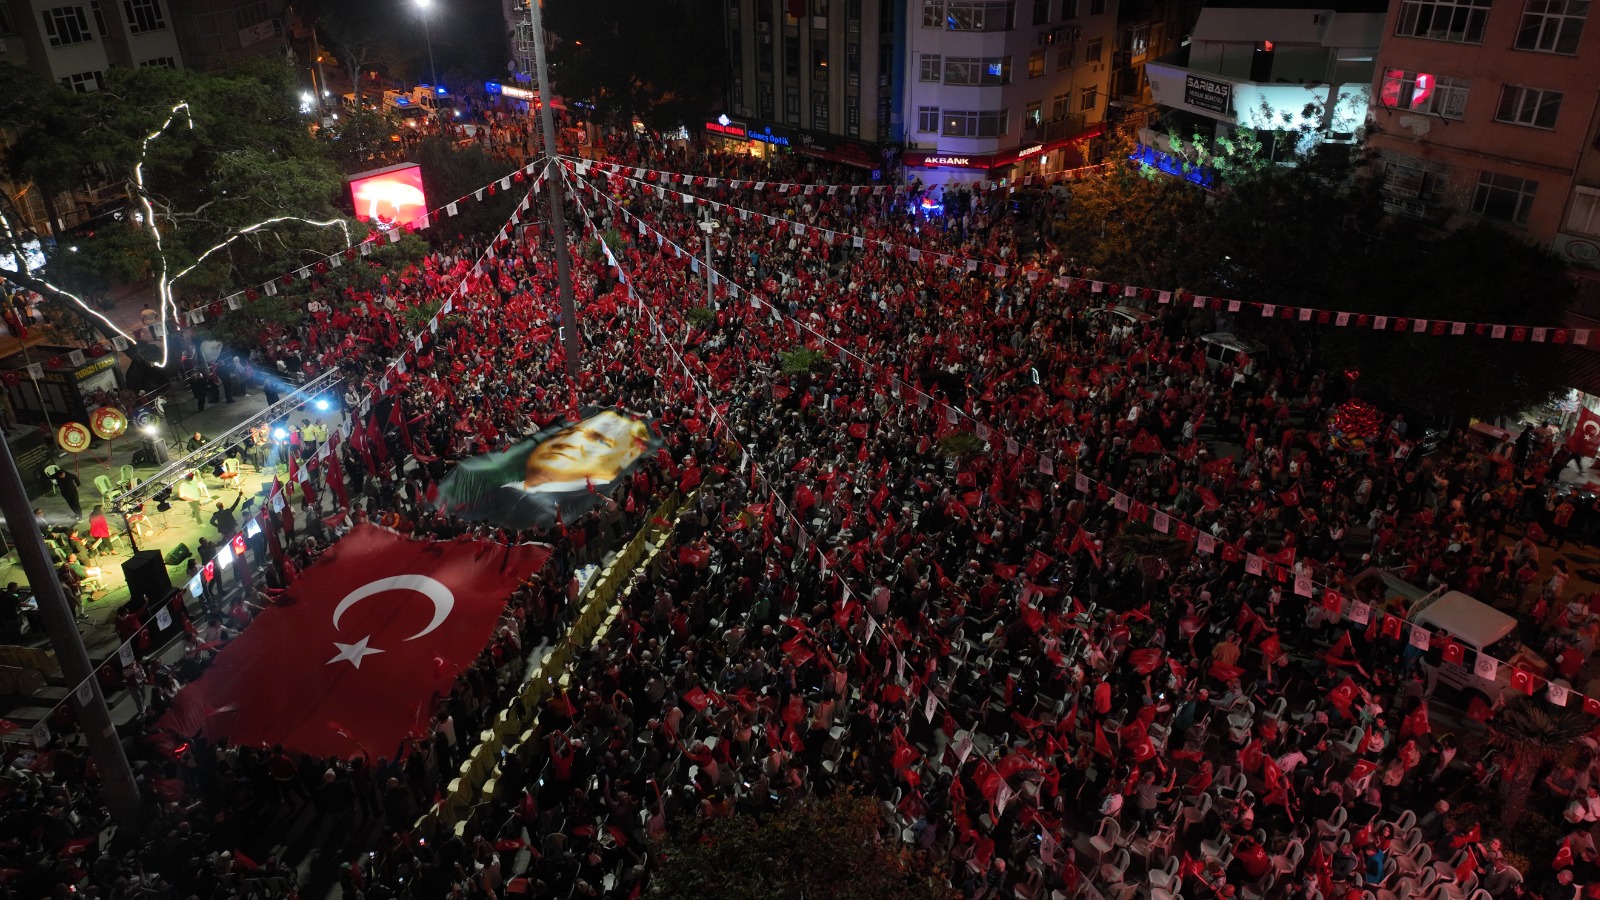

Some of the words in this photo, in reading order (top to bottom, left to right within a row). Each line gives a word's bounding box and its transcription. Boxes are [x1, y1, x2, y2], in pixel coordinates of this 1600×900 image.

[1187, 78, 1228, 97] SARIBAŞ
[769, 135, 789, 146] Optik
[1018, 144, 1043, 157] AKBANK
[924, 157, 969, 165] AKBANK
